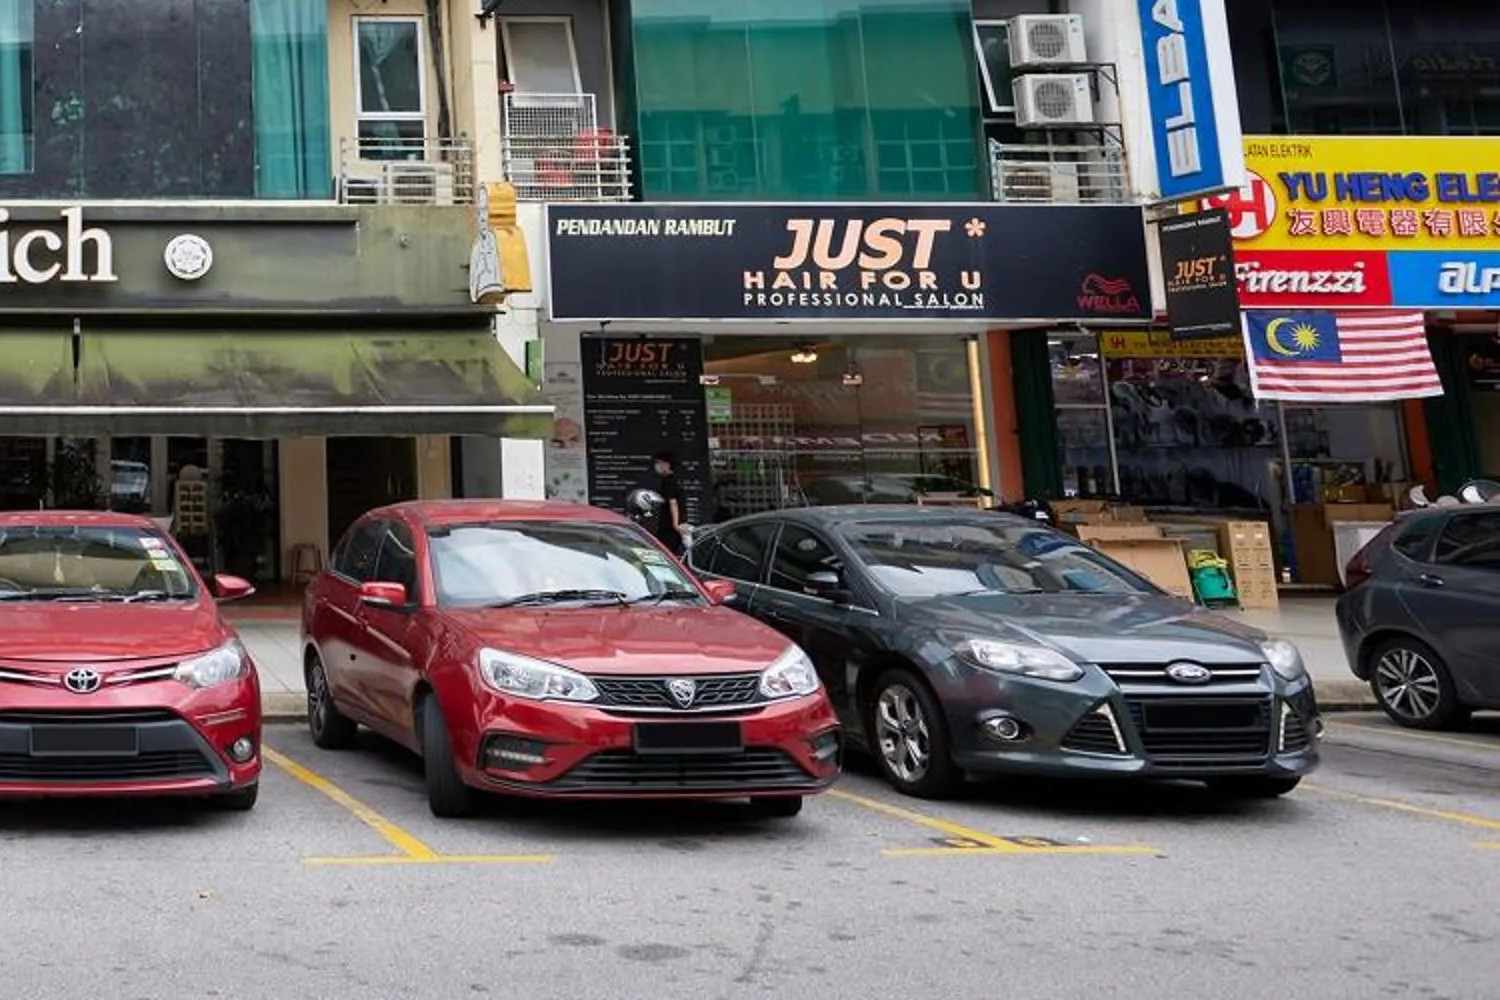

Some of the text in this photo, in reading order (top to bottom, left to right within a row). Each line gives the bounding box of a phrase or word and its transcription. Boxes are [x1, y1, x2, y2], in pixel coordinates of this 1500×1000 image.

[1277, 171, 1329, 202] YU
[1335, 171, 1431, 202] HENG
[556, 219, 737, 236] PENDANDAN RAMBUT
[772, 217, 952, 271] JUST
[1174, 257, 1217, 280] JUST
[743, 270, 982, 290] HAIR FOR U
[743, 292, 902, 307] PROFESSIONAL
[913, 292, 985, 307] SALON
[1075, 294, 1143, 313] WELLA
[609, 342, 674, 363] JUST
